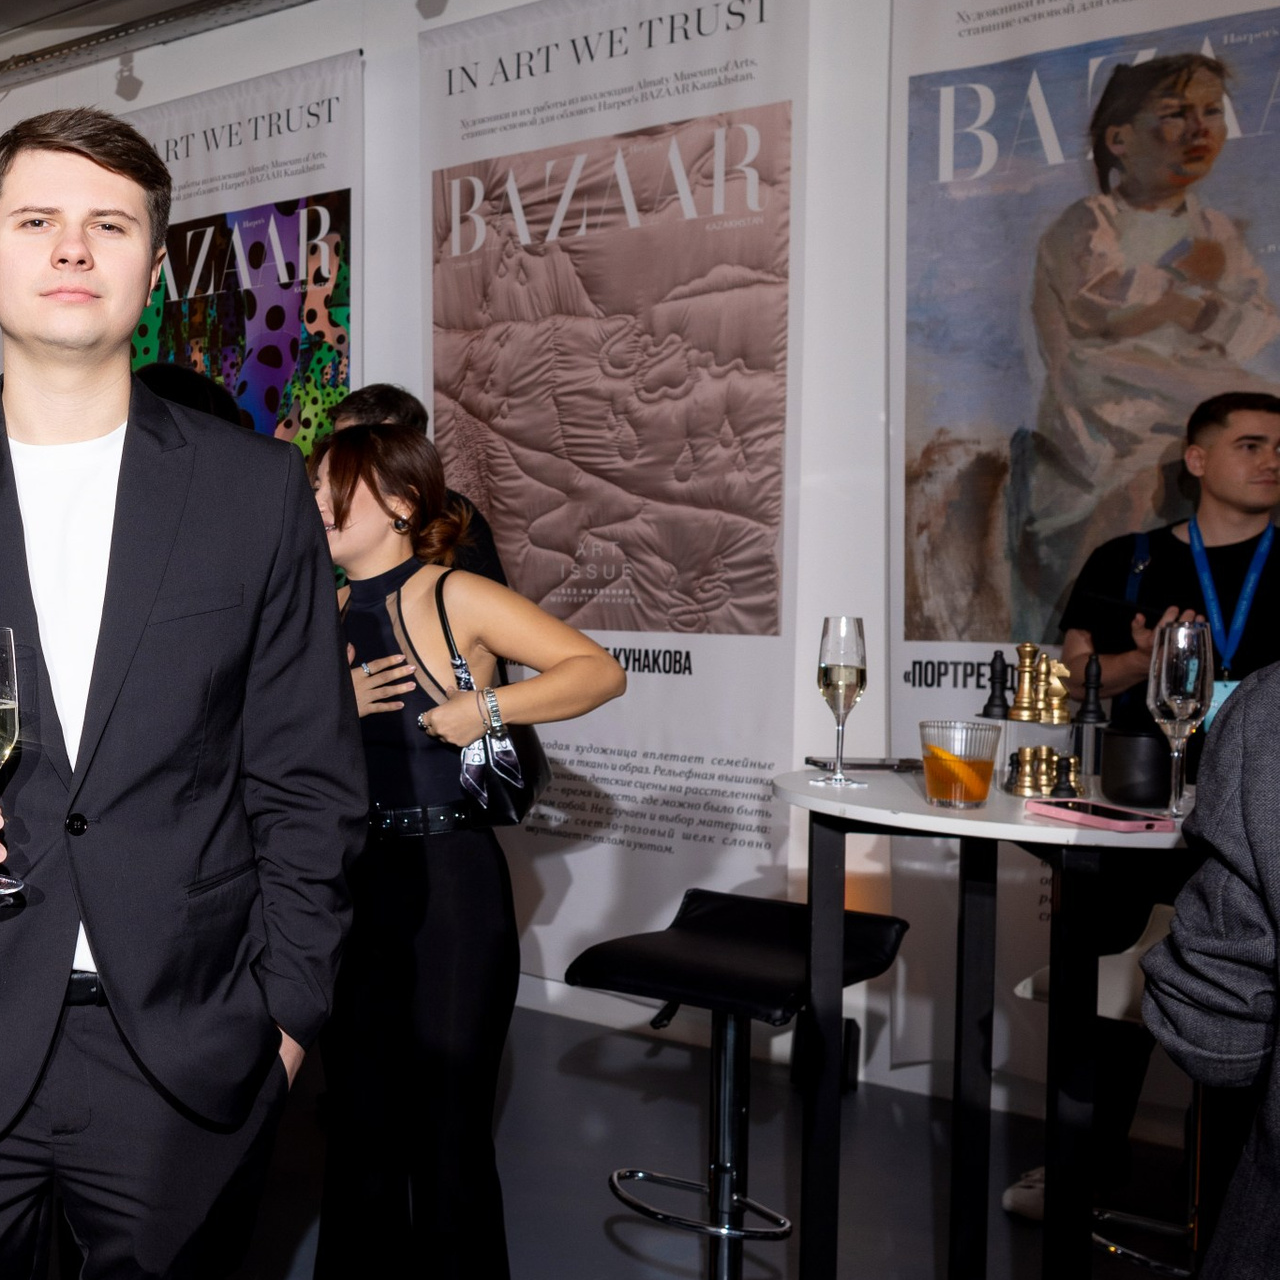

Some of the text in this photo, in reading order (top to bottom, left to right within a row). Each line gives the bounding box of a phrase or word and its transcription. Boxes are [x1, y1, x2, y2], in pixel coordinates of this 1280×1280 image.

[444, 61, 481, 97] IN
[488, 43, 560, 87] ART
[570, 25, 629, 67] WE
[634, 76, 669, 93] Almaty
[672, 66, 718, 83] Museum
[718, 61, 730, 73] of
[598, 94, 639, 112] Harper's
[639, 84, 690, 104] BAZAAR
[153, 96, 340, 162] RT WE TRUST
[249, 170, 283, 187] BAZAAR
[447, 123, 770, 258] BAZAAR
[575, 541, 619, 557] ART
[560, 563, 633, 580] ISSUE
[903, 659, 992, 690] «ПОРТРЕ
[575, 742, 638, 758] художница
[642, 750, 705, 765] вплетает
[710, 756, 775, 771] семейные
[576, 758, 609, 770] ткань
[610, 762, 618, 771] и
[618, 761, 651, 775] образ.
[653, 764, 716, 782] Рельефная
[561, 786, 592, 798] время
[593, 789, 601, 799] и
[602, 790, 639, 804] место,
[640, 794, 659, 806] где
[660, 798, 701, 811] можно
[702, 800, 735, 815] было
[736, 804, 773, 820] быть
[588, 772, 633, 787] детские
[633, 780, 667, 792] сцены
[669, 784, 683, 794] на
[683, 785, 773, 803] расстеленных
[590, 800, 605, 814] Не
[605, 805, 648, 820] случаен
[649, 812, 657, 821] и
[658, 812, 695, 827] выбор
[696, 819, 771, 835] материала:
[574, 817, 675, 840] светло-розовый
[682, 830, 716, 844] шелк
[721, 835, 772, 851] словно
[582, 832, 625, 846] теплом
